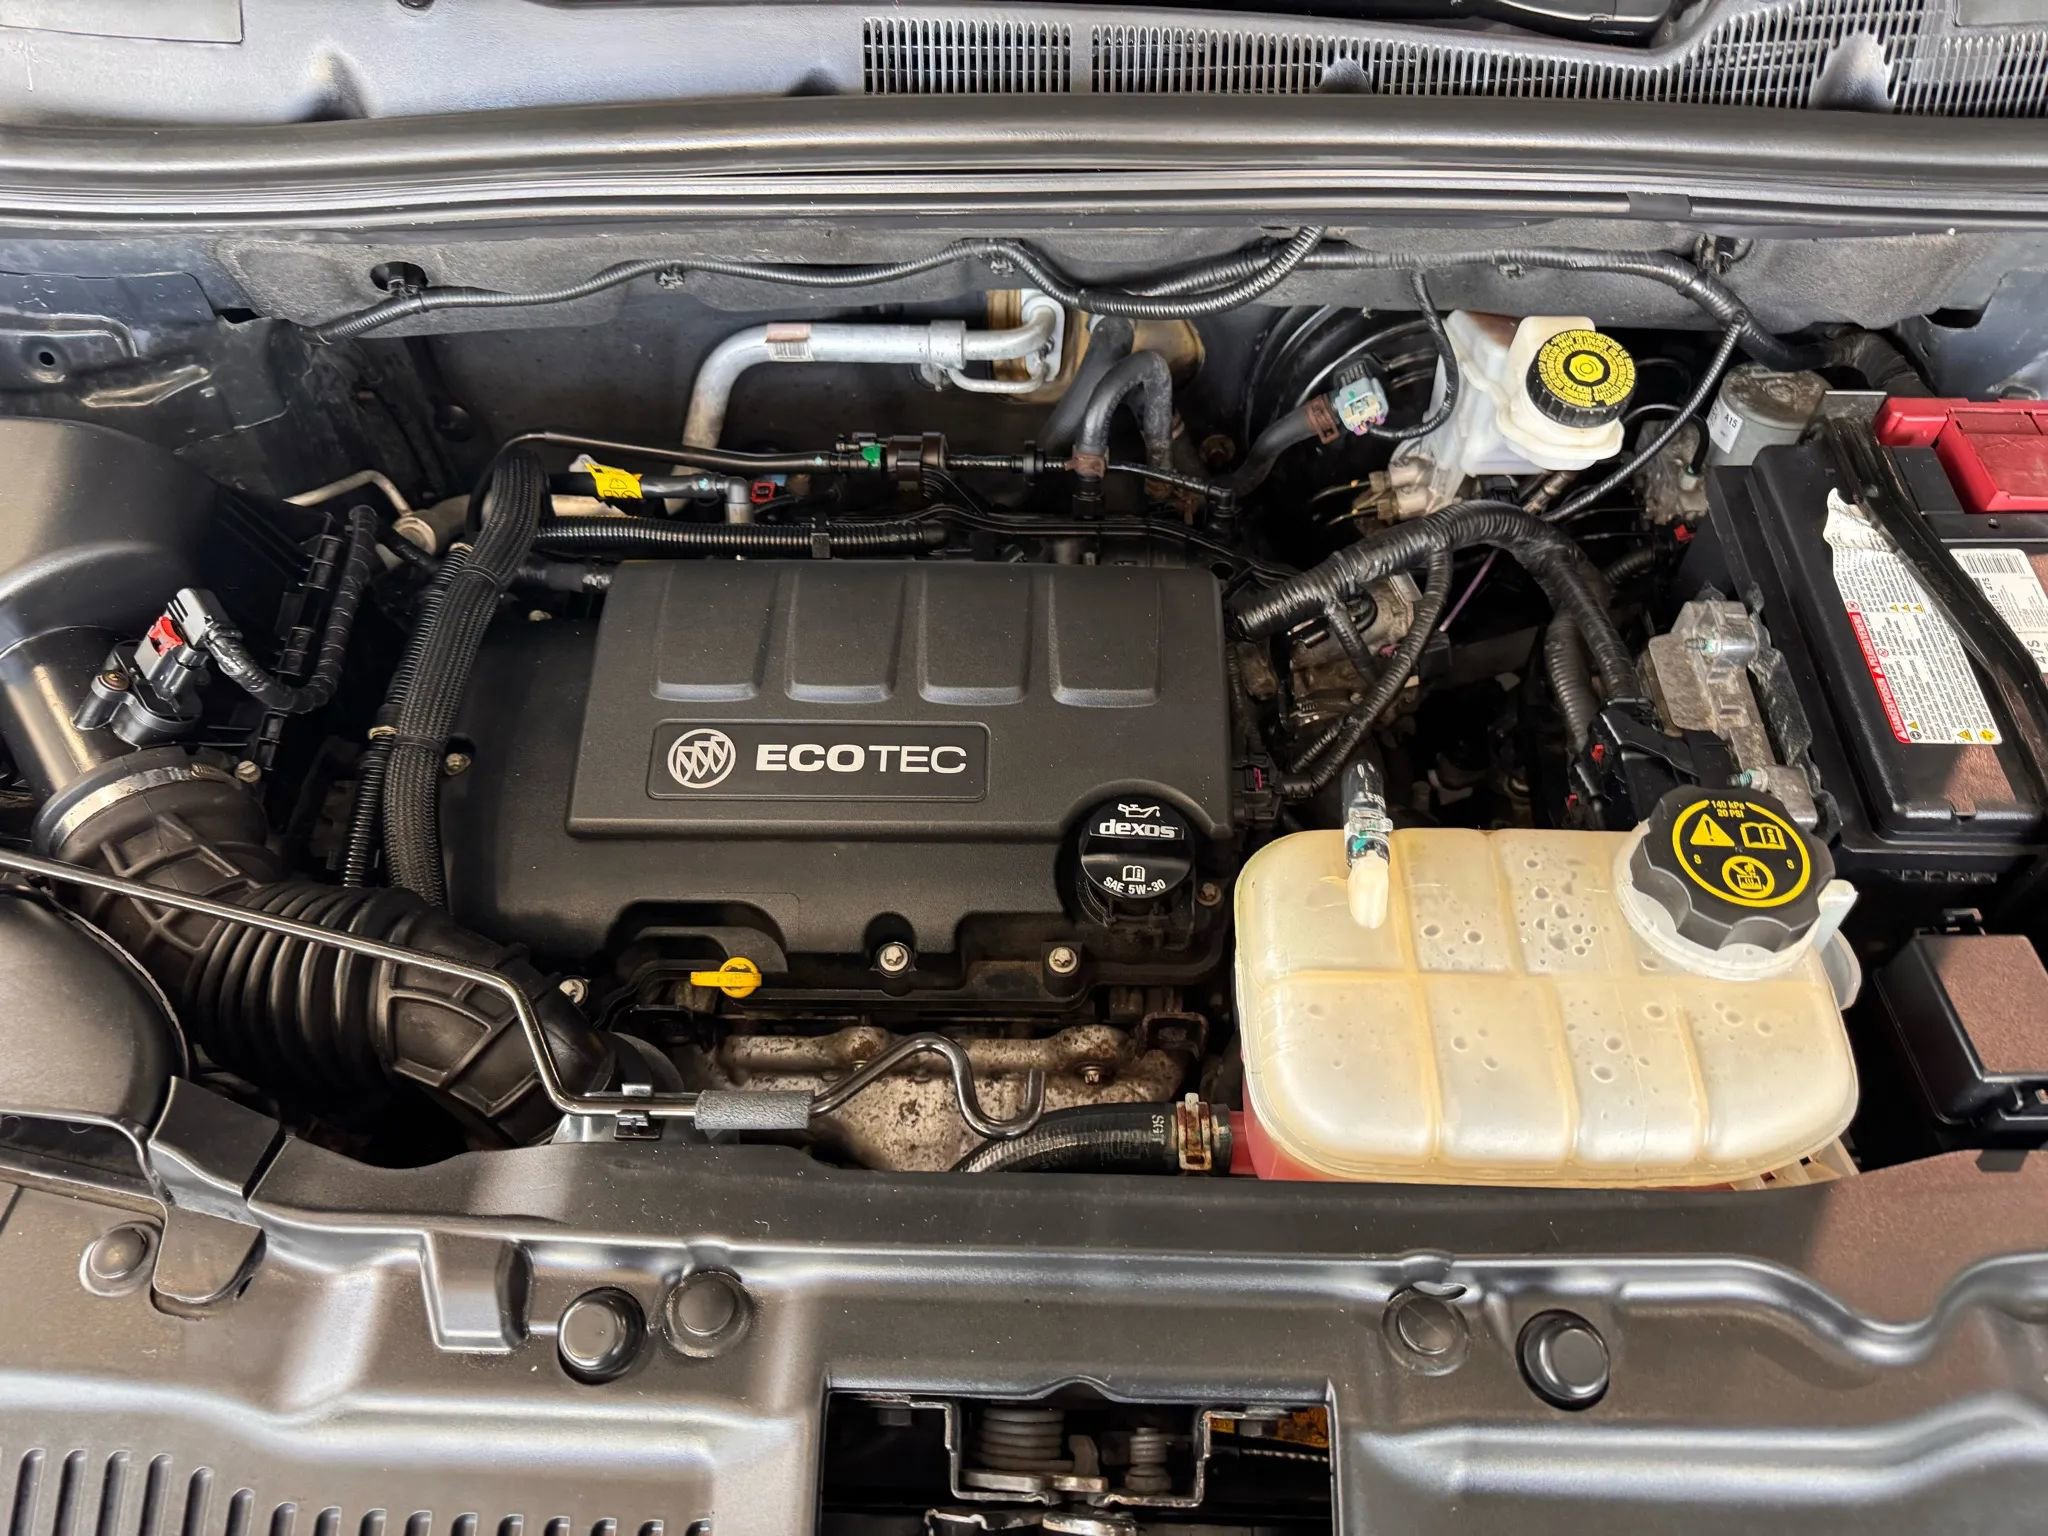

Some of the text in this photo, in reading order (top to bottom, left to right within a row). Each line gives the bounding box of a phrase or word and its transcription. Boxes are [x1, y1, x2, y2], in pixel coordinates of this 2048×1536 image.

[755, 743, 968, 774] ECOTEC
[1711, 800, 1745, 810] 140 kPa
[1717, 809, 1745, 818] 20 PSI
[1099, 818, 1175, 838] dexos
[1103, 876, 1166, 895] SAE 5W-30
